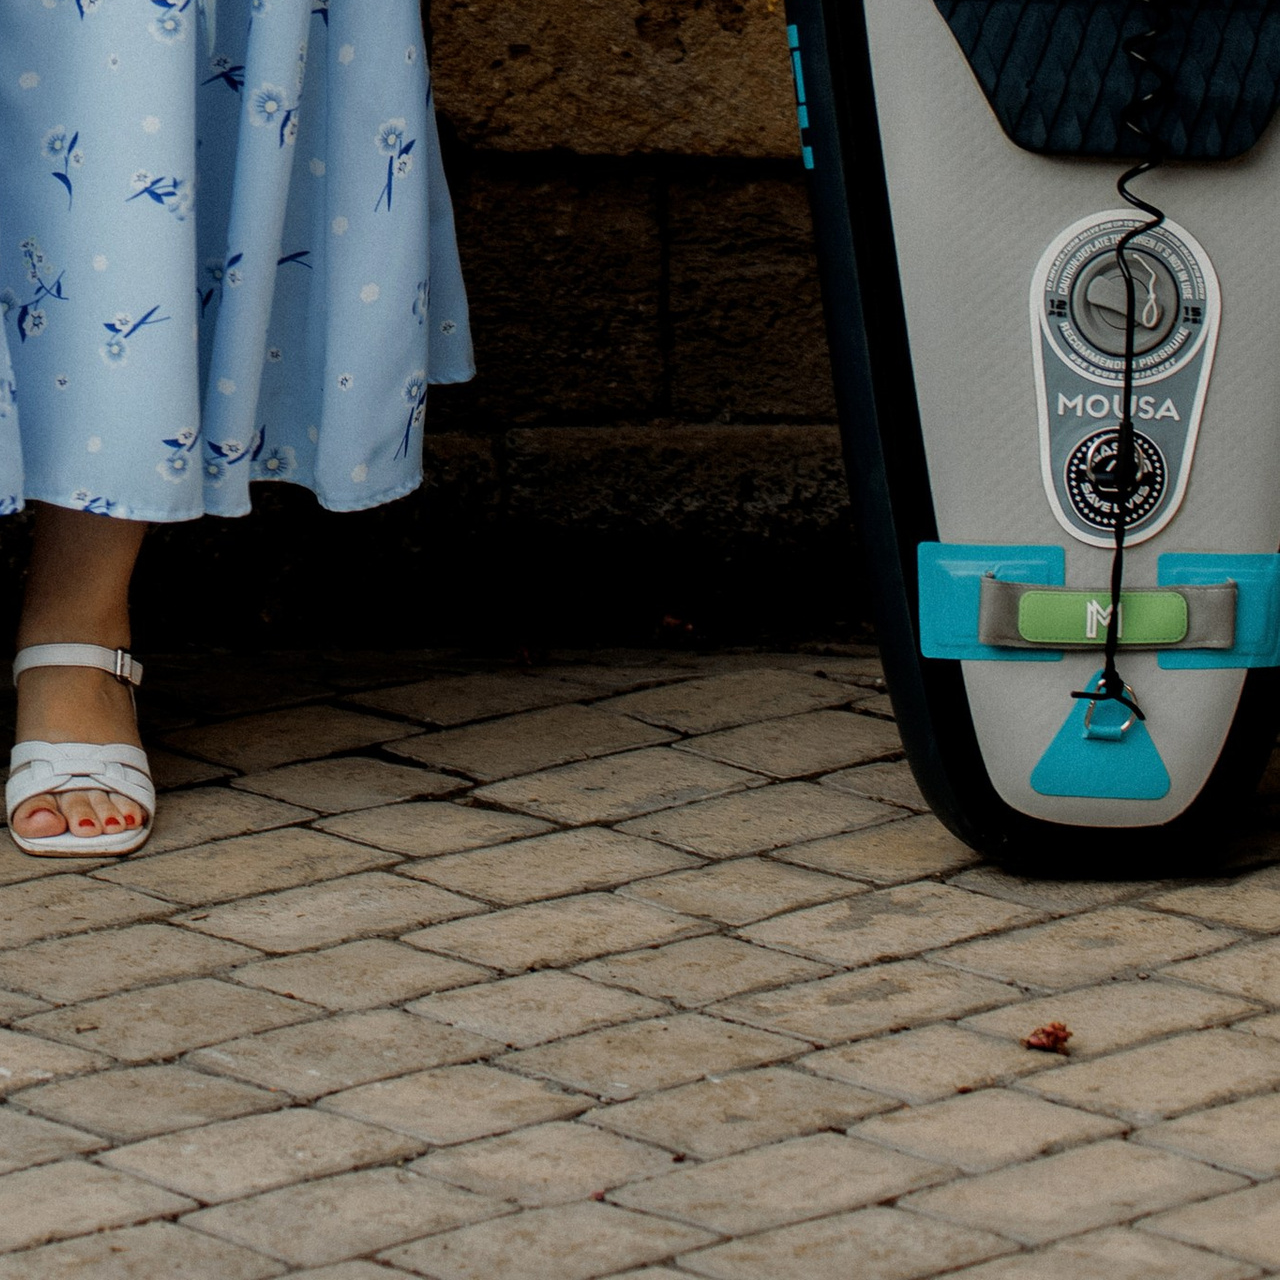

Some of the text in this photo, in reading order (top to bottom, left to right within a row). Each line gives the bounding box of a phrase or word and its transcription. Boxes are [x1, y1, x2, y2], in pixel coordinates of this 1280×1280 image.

[1167, 254, 1185, 271] NOT
[1177, 270, 1190, 282] IN
[1181, 281, 1193, 300] USE
[1049, 299, 1067, 310] 12
[1183, 305, 1202, 317] 15
[1139, 326, 1190, 368] PRESSURE
[1088, 365, 1116, 379] YOUR
[1057, 392, 1181, 421] MOUSA
[1080, 482, 1151, 514] SAVE LVES
